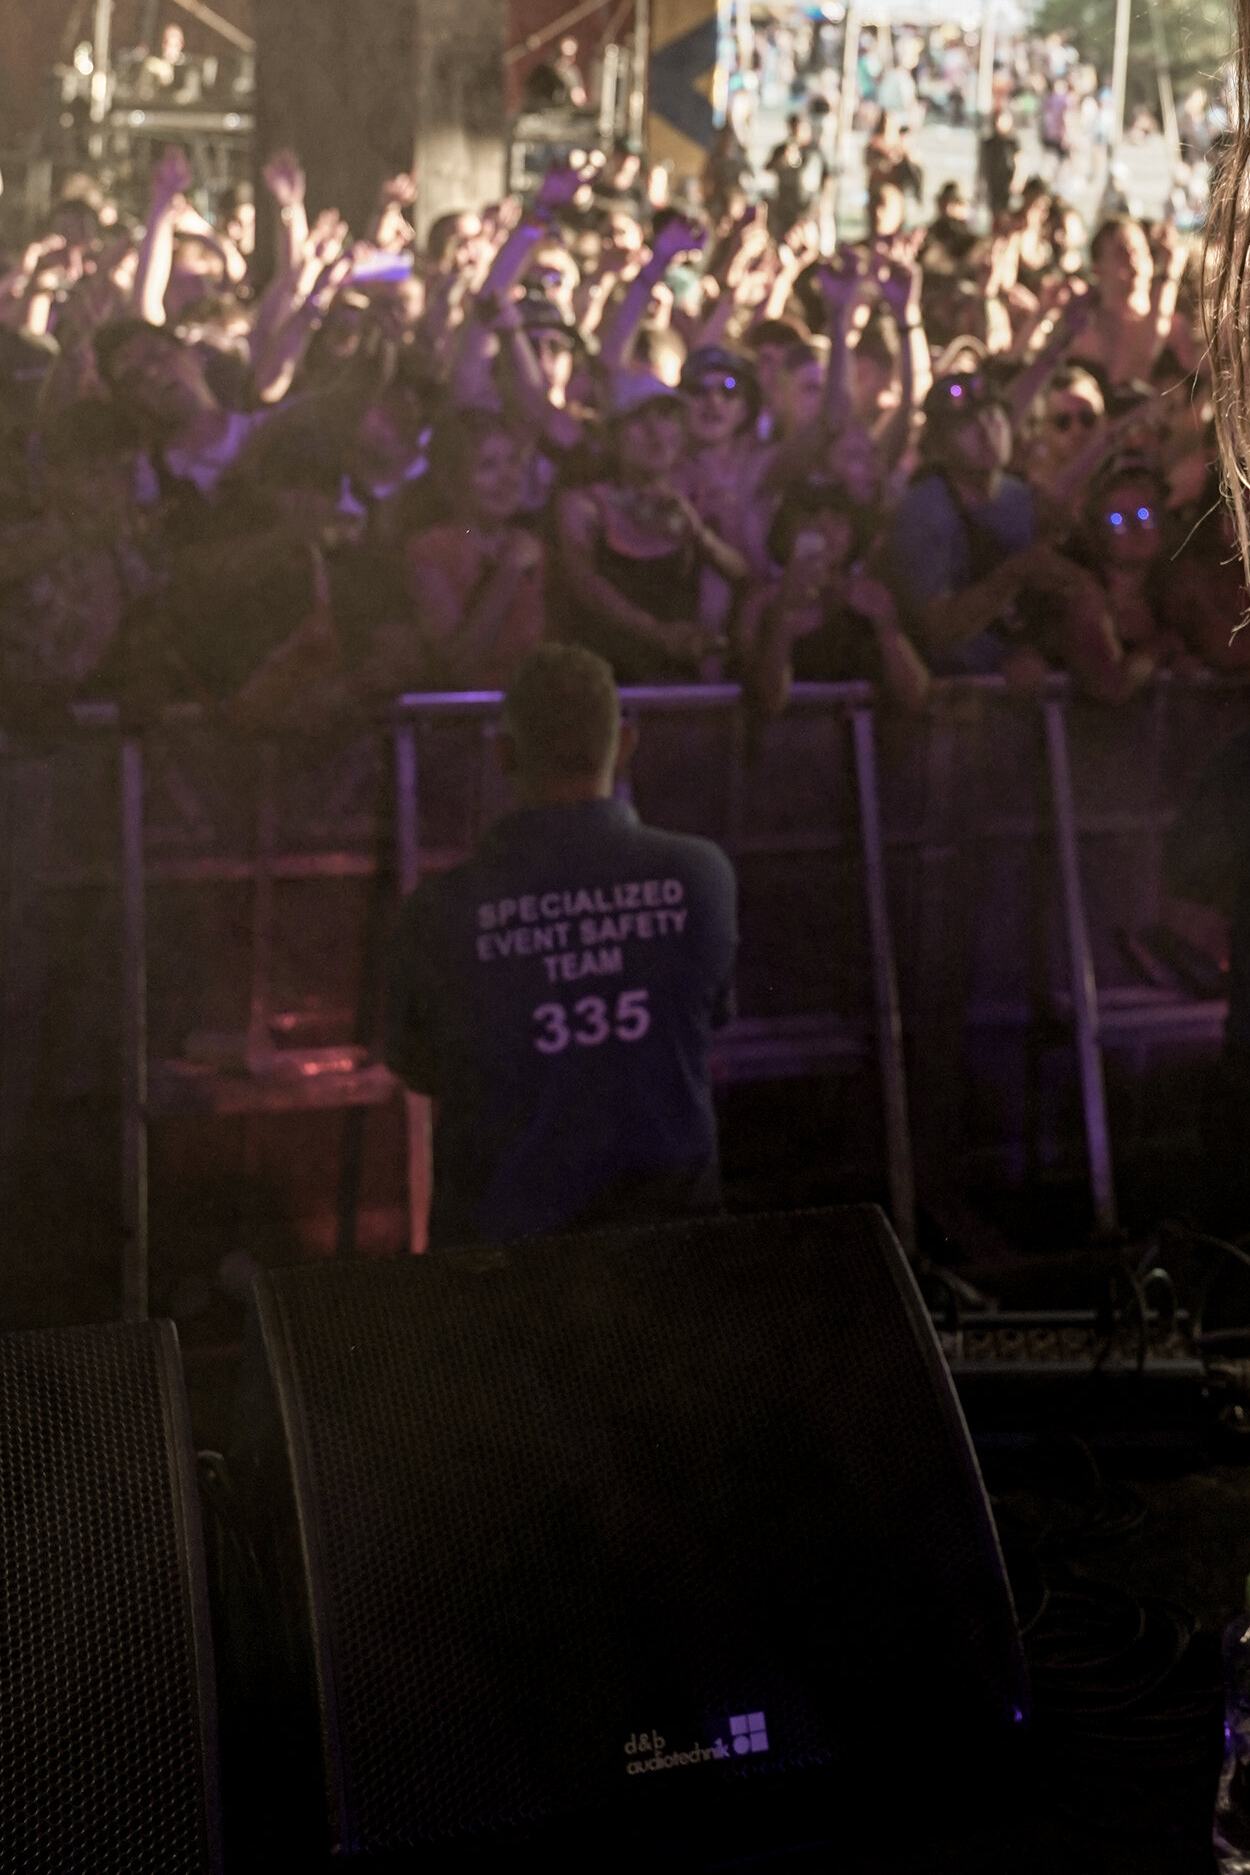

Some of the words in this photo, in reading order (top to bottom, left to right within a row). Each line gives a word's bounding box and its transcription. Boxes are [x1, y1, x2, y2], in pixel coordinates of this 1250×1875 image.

[478, 878, 683, 929] SPECIALIZED
[477, 923, 570, 961] EVENT
[580, 909, 687, 945] SAFETY
[545, 946, 622, 982] TEAM
[532, 988, 650, 1053] 335
[624, 1730, 666, 1755] d&b
